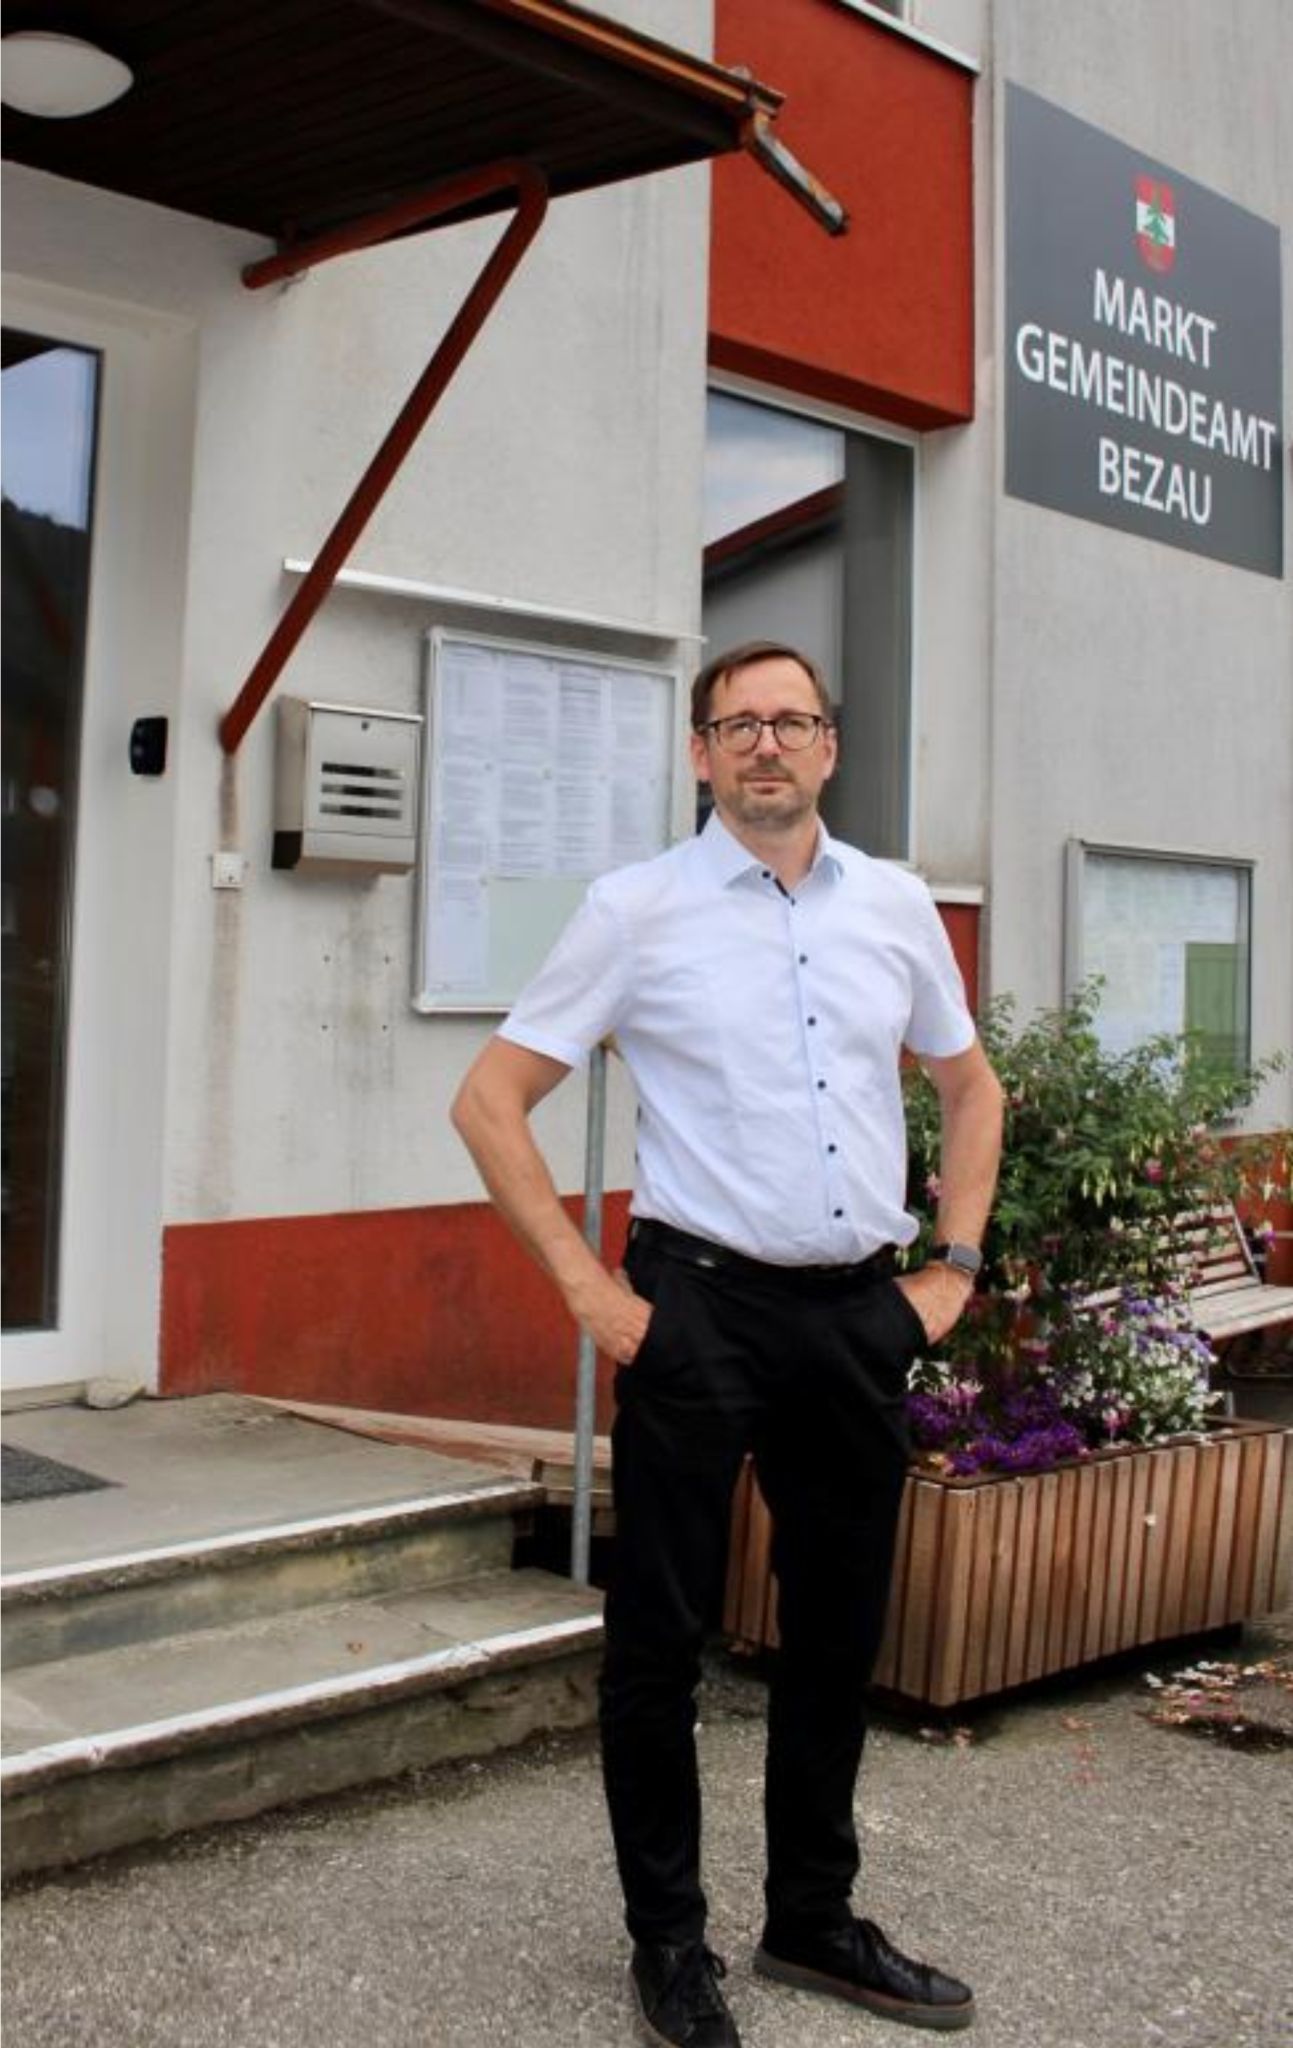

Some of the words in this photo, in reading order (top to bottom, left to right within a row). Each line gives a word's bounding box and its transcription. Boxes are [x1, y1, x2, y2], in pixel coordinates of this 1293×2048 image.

[1093, 268, 1217, 369] MARKT
[1015, 323, 1276, 471] GEMEINDEAMT
[1099, 437, 1211, 525] BEZAU
